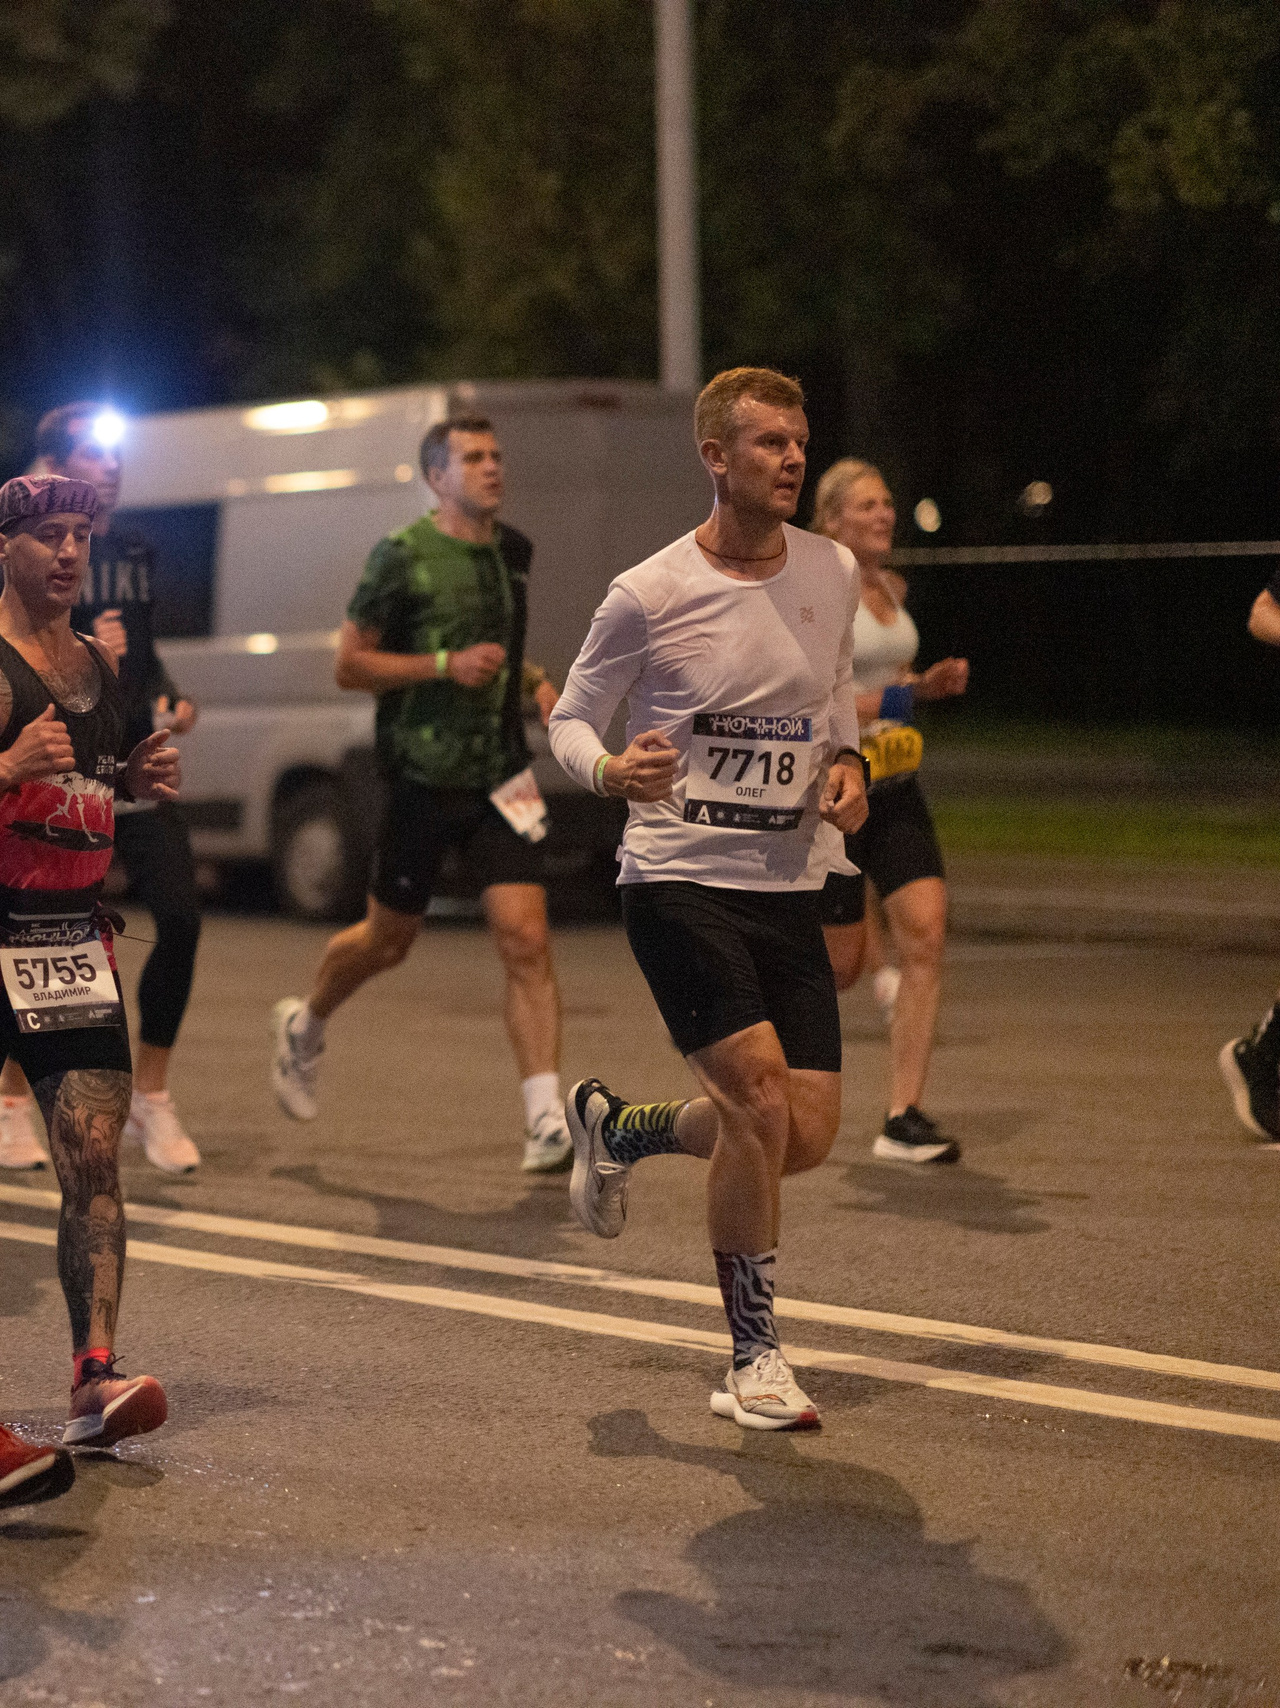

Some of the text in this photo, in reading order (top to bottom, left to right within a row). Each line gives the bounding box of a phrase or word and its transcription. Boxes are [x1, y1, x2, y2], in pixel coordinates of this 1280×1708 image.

[707, 746, 796, 785] 7718
[735, 786, 767, 798] ОЛЕГ
[13, 953, 97, 990] 5755
[32, 986, 91, 1001] ВЛАДИМИР
